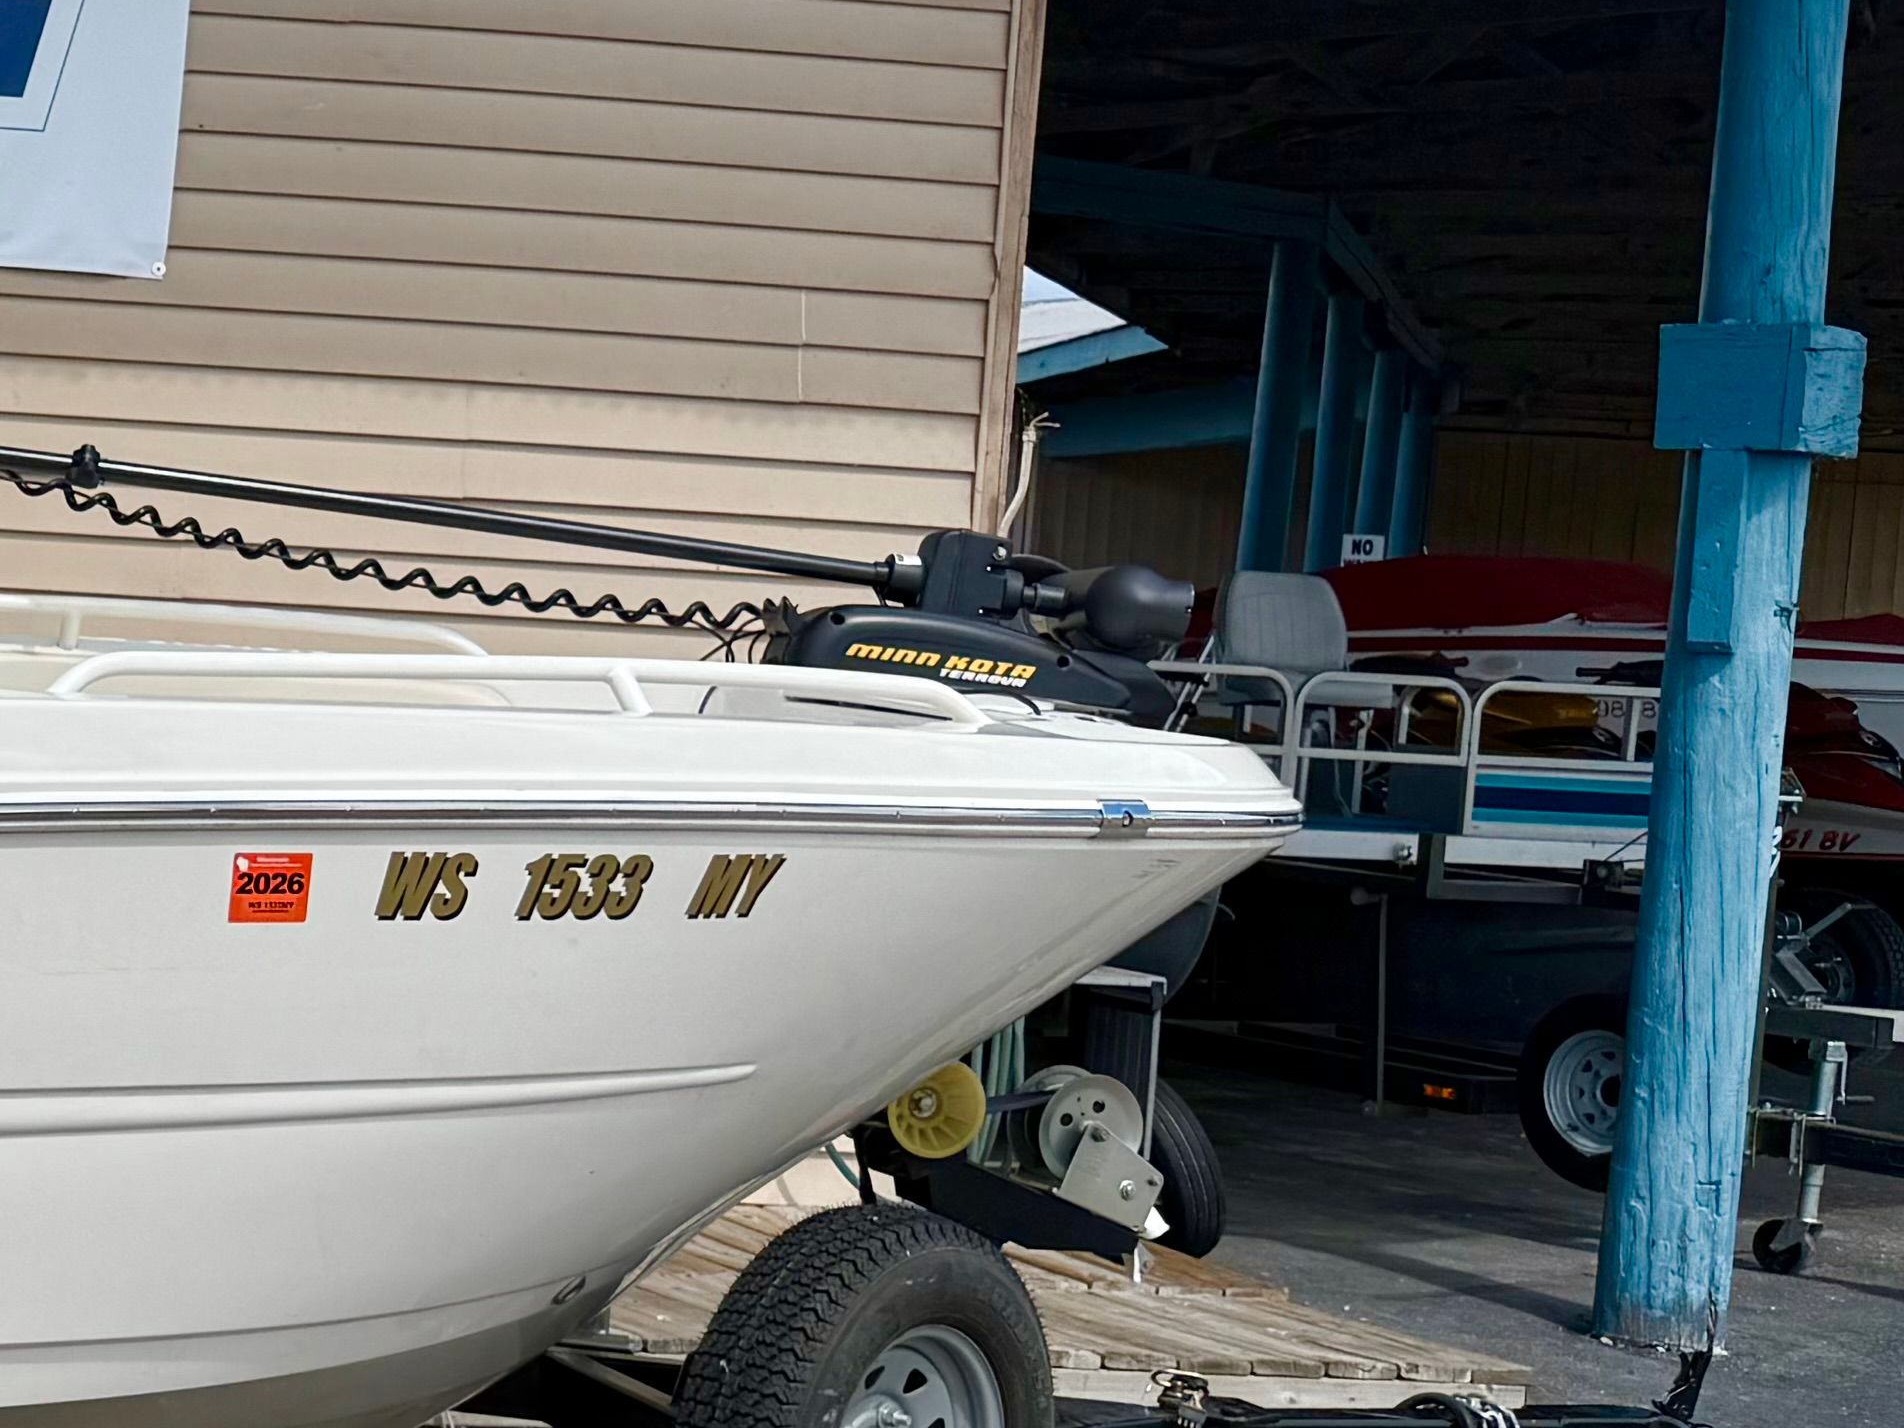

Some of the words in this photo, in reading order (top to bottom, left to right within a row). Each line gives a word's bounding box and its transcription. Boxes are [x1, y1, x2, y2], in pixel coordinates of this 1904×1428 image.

[1351, 538, 1374, 556] NO
[845, 643, 942, 667] MINN
[944, 655, 1037, 679] KOTA
[235, 872, 305, 894] 2026
[374, 851, 478, 922] WS
[514, 853, 655, 922] 1533
[683, 853, 788, 920] MY
